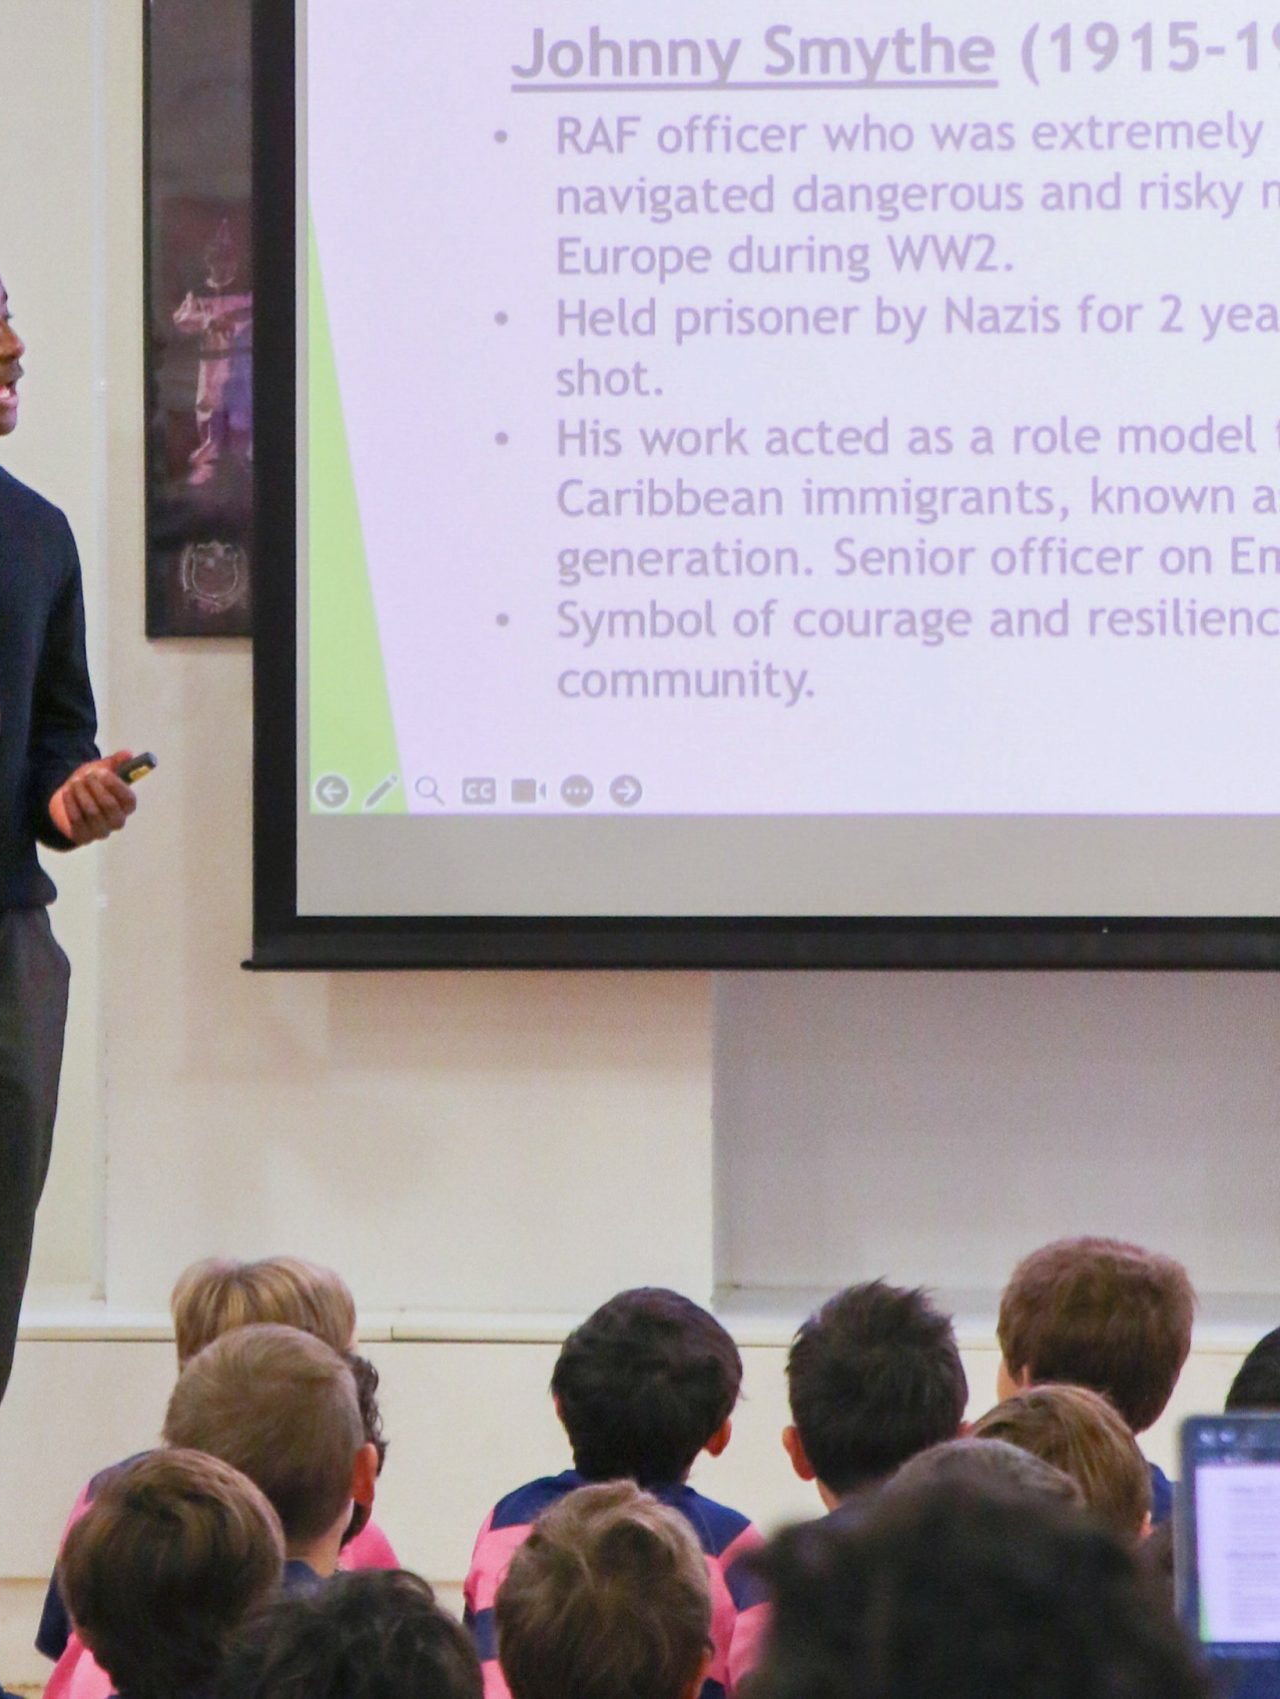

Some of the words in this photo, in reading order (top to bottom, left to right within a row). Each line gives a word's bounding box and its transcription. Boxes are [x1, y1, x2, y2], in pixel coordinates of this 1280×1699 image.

[511, 25, 741, 86] Johnny
[763, 23, 996, 86] Smythe
[1021, 21, 1280, 86] (1915-1
[557, 115, 641, 154] RAF
[657, 114, 807, 154] officer
[823, 112, 914, 152] who
[930, 122, 1015, 151] was
[1032, 110, 1264, 159] extremely
[557, 174, 774, 224] navigated
[793, 174, 1024, 222] dangerous
[1041, 171, 1121, 211] and
[1140, 171, 1244, 220] risky
[558, 237, 712, 284] Europe
[728, 234, 870, 283] during
[887, 233, 1013, 272] WW2.
[558, 297, 655, 336] Held
[675, 298, 860, 346] prisoner
[876, 296, 927, 344] by
[945, 295, 1061, 334] Nazis
[1078, 294, 1143, 334] for
[1160, 293, 1184, 333] 2
[557, 358, 662, 396] shot.
[558, 419, 622, 457] His
[639, 417, 748, 456] work
[765, 416, 889, 456] acted
[908, 426, 953, 455] as
[970, 426, 994, 455] a
[1014, 415, 1101, 455] role
[1119, 414, 1256, 454] model
[557, 478, 782, 517] Caribbean
[802, 478, 1069, 525] immigrants,
[1091, 475, 1234, 514] known
[1253, 485, 1280, 514] a
[557, 538, 812, 587] generation.
[835, 537, 976, 576] Senior
[991, 536, 1143, 576] officer
[1159, 546, 1212, 575] on
[558, 599, 716, 647] Symbol
[733, 598, 778, 637] of
[793, 608, 972, 647] courage
[990, 598, 1069, 637] and
[558, 660, 814, 707] community.
